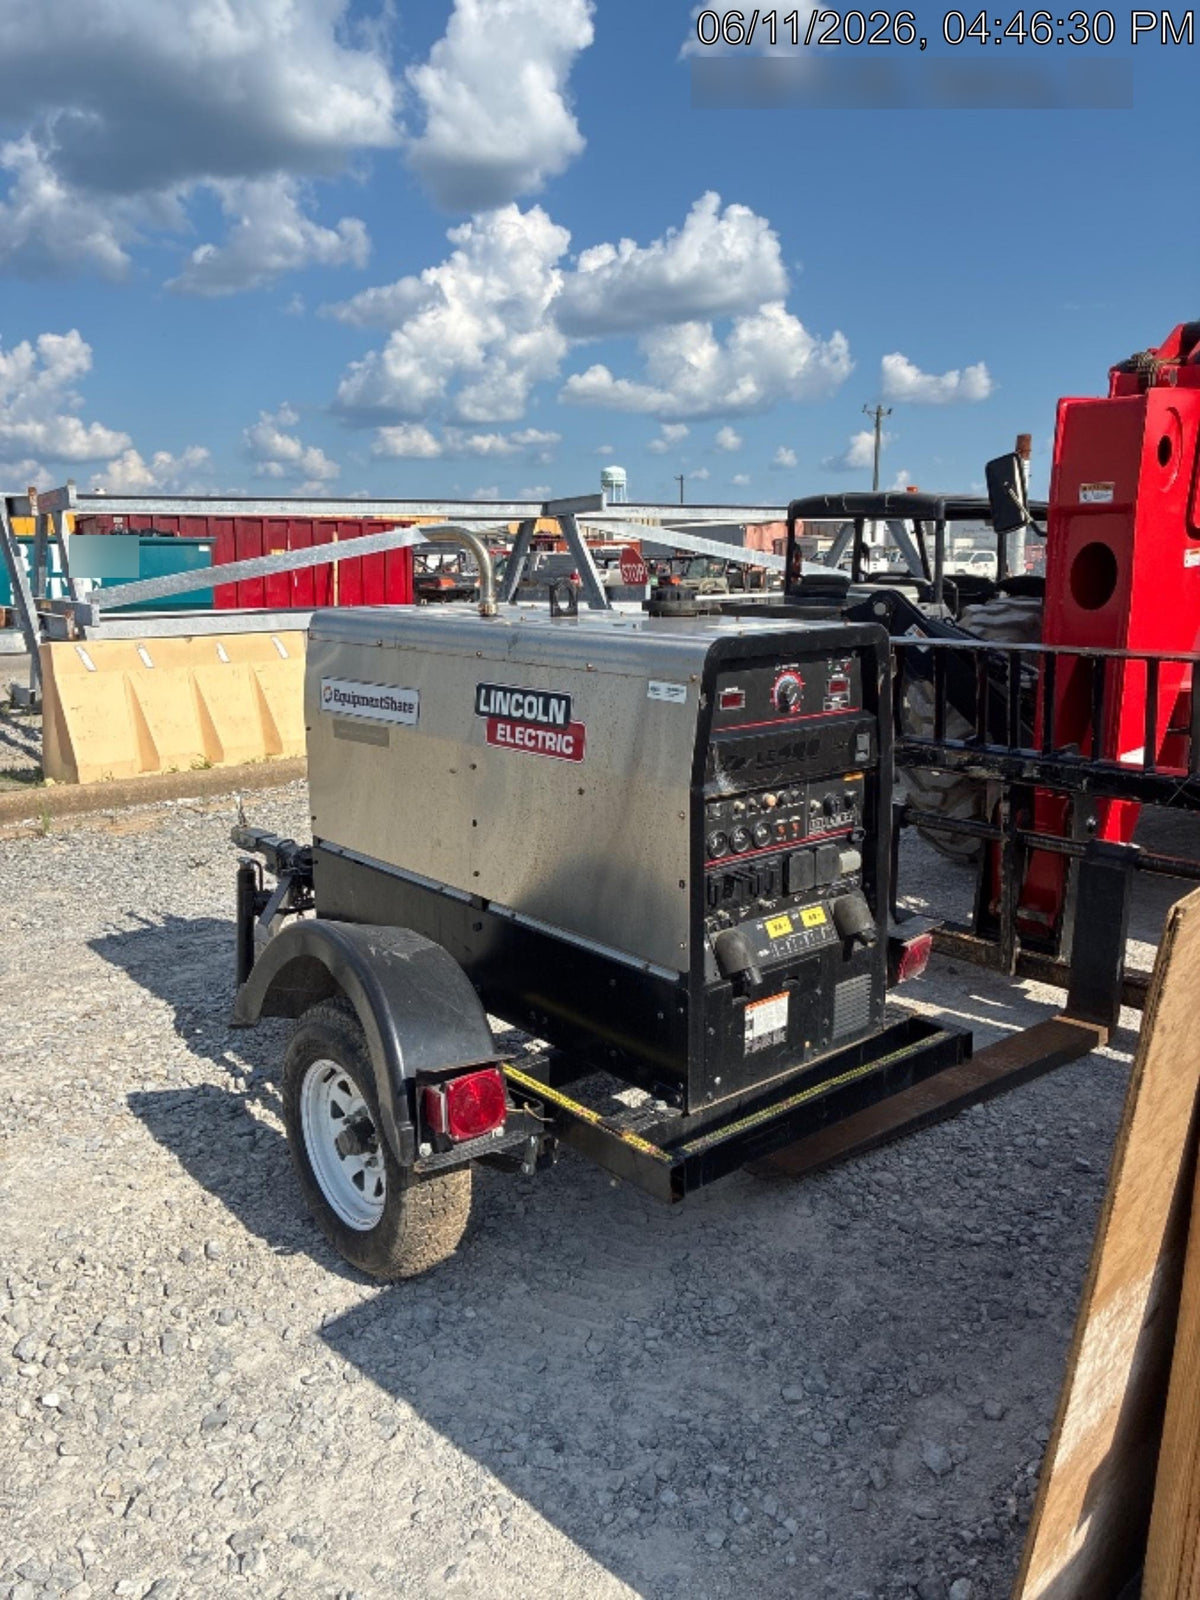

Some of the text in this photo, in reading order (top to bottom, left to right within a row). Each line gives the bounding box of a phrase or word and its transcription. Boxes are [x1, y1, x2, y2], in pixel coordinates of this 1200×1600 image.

[622, 563, 644, 582] STOP
[334, 688, 415, 714] EquipmentShare
[479, 688, 566, 725] LINCOLN
[496, 723, 574, 754] ELECTRIC
